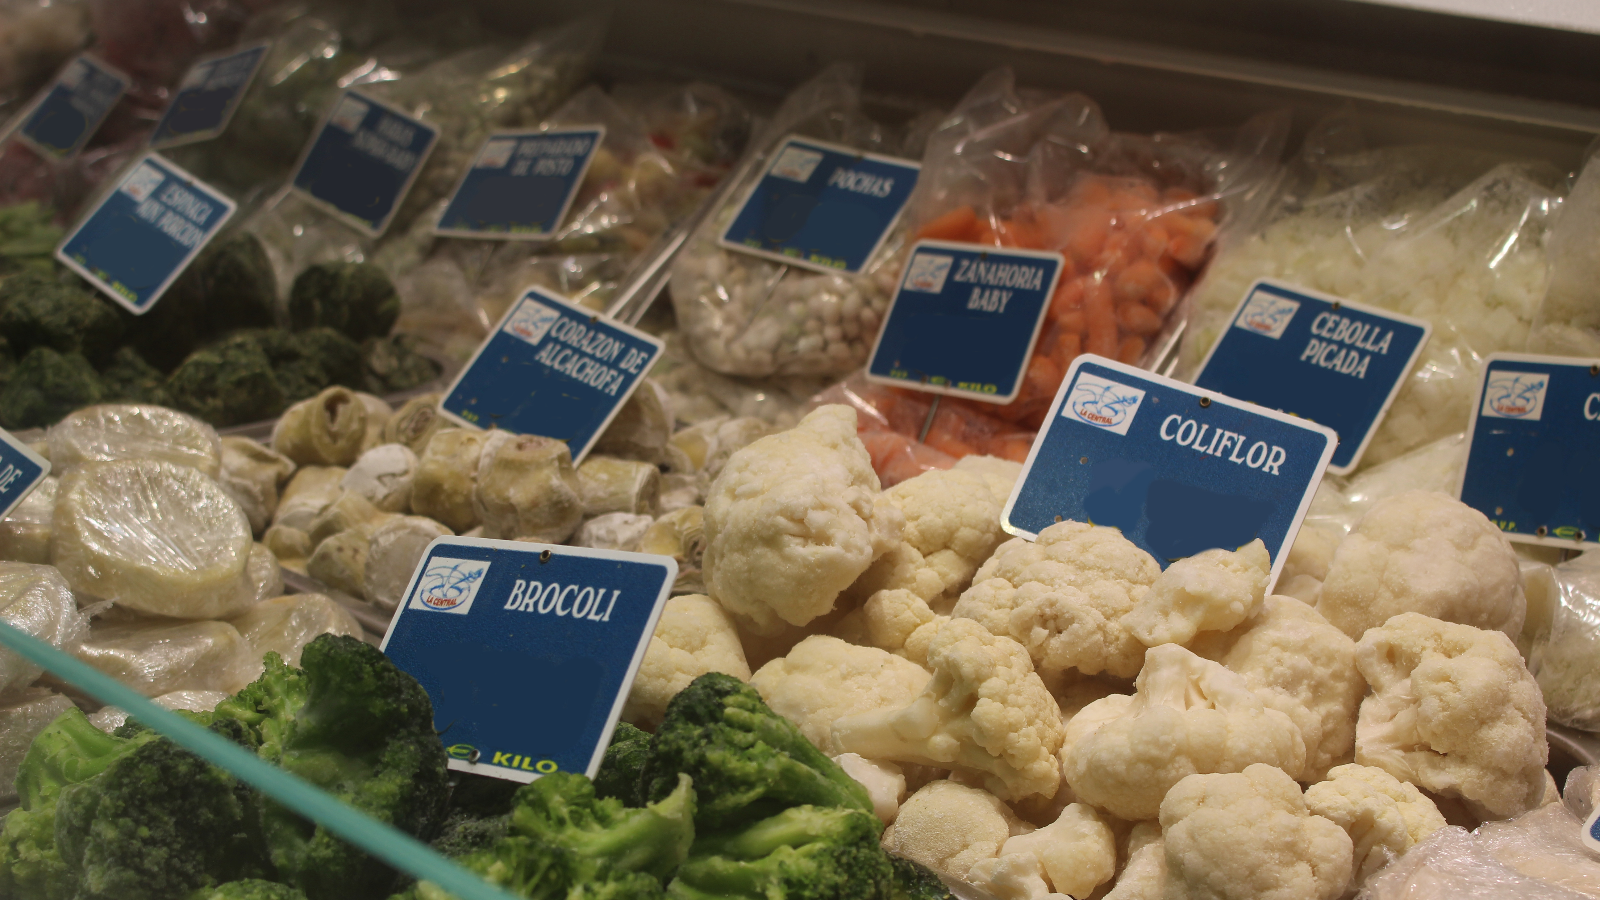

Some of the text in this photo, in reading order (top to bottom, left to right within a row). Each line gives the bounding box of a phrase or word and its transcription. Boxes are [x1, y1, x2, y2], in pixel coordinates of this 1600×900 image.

[954, 259, 1044, 291] ZANAHORIA
[967, 287, 1013, 314] BABY
[550, 316, 649, 375] CORAZON DE
[1310, 311, 1394, 355] CEBOLLA
[534, 341, 625, 396] ALCACHOFA
[1299, 338, 1371, 379] PICADA
[1079, 408, 1112, 425] LA CENTRAL
[1159, 414, 1286, 476] COLIFLOR
[503, 579, 621, 622] BROCOLI
[492, 751, 559, 774] KILO
